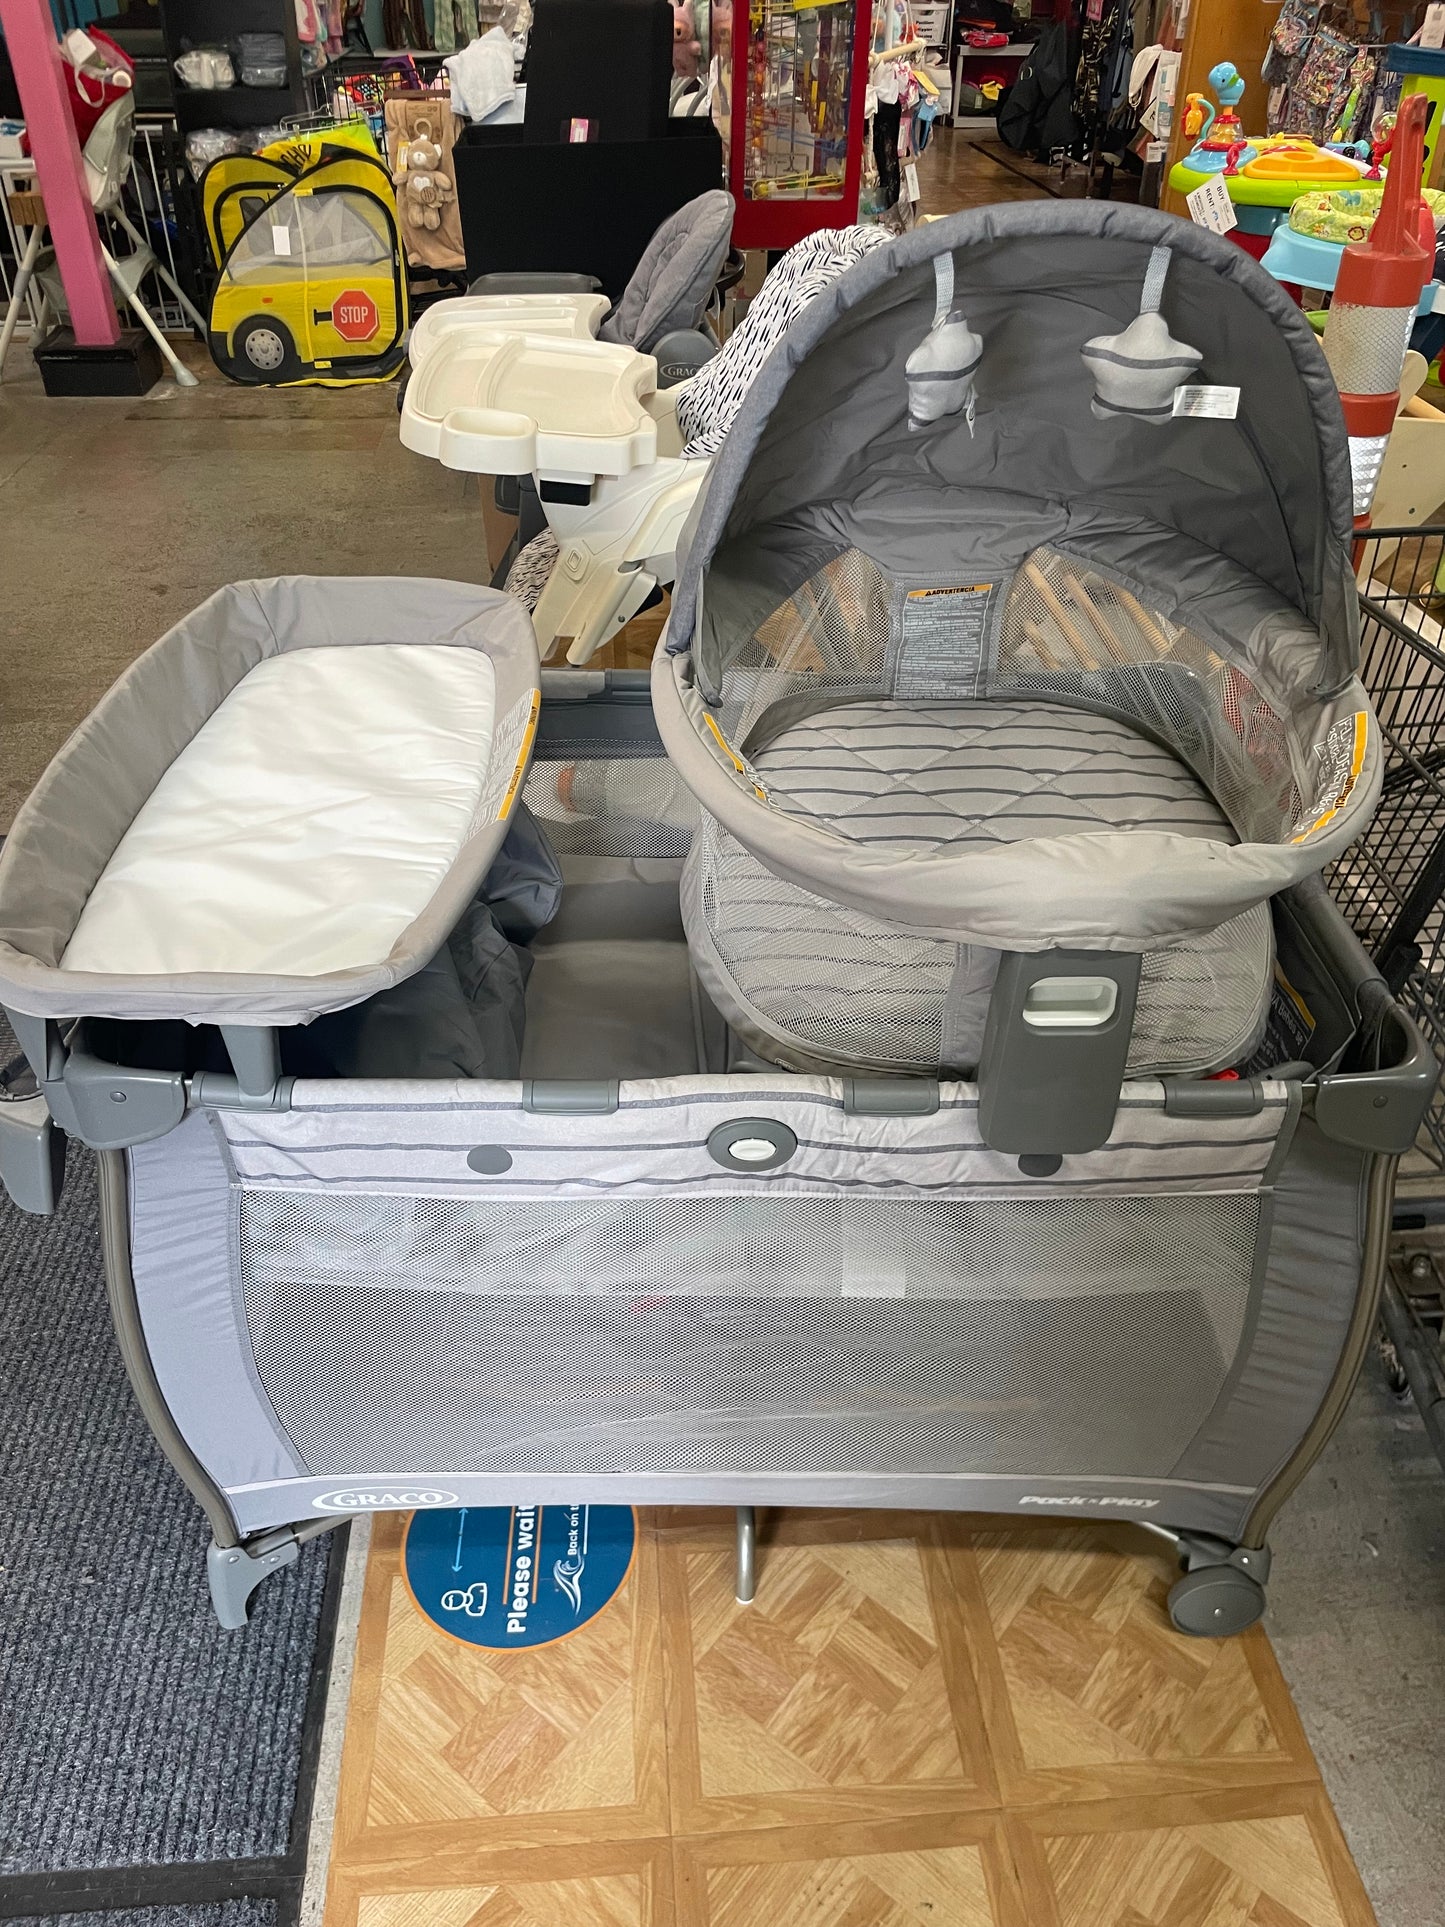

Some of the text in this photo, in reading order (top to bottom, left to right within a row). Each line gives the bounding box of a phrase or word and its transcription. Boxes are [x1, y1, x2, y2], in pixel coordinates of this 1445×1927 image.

[340, 306, 369, 324] STOP
[667, 367, 698, 377] GRAC
[932, 586, 975, 595] ADVERTENCIA
[333, 1493, 443, 1506] GRACO
[1018, 1496, 1088, 1505] Pack
[1098, 1496, 1160, 1508] Play
[570, 1513, 580, 1527] on
[567, 1529, 579, 1556] Back
[507, 1555, 532, 1633] Please
